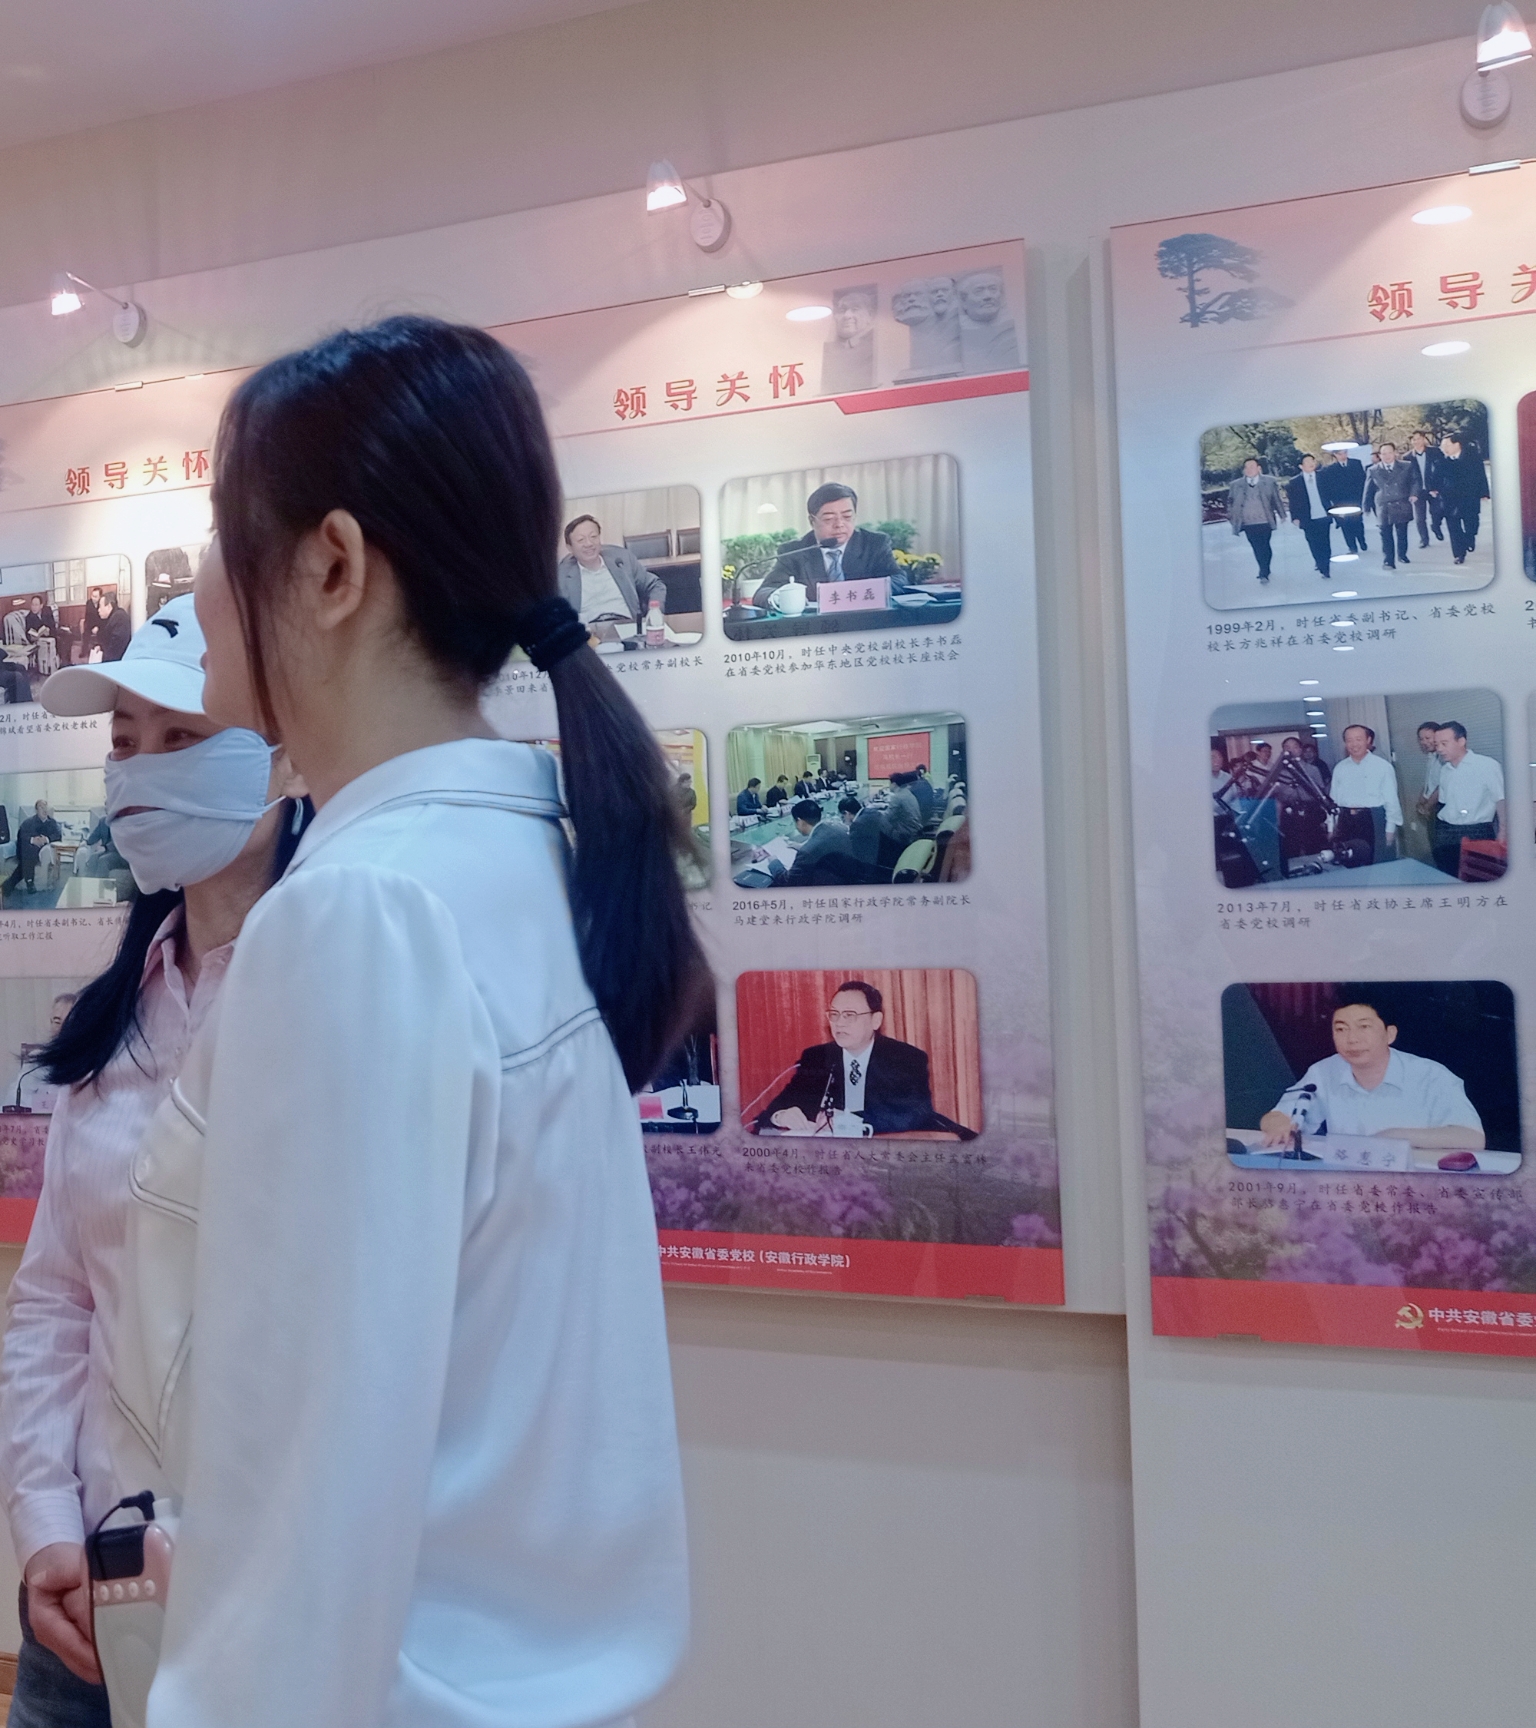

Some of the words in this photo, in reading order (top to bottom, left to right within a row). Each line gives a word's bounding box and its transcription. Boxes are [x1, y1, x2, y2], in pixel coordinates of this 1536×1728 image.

[613, 362, 805, 420] 领导关怀
[65, 449, 209, 496] 领导关怀
[828, 588, 876, 606] 李书磊
[1219, 917, 1312, 930] 省委党校调研
[1428, 1307, 1536, 1329] 中共安徽省委
